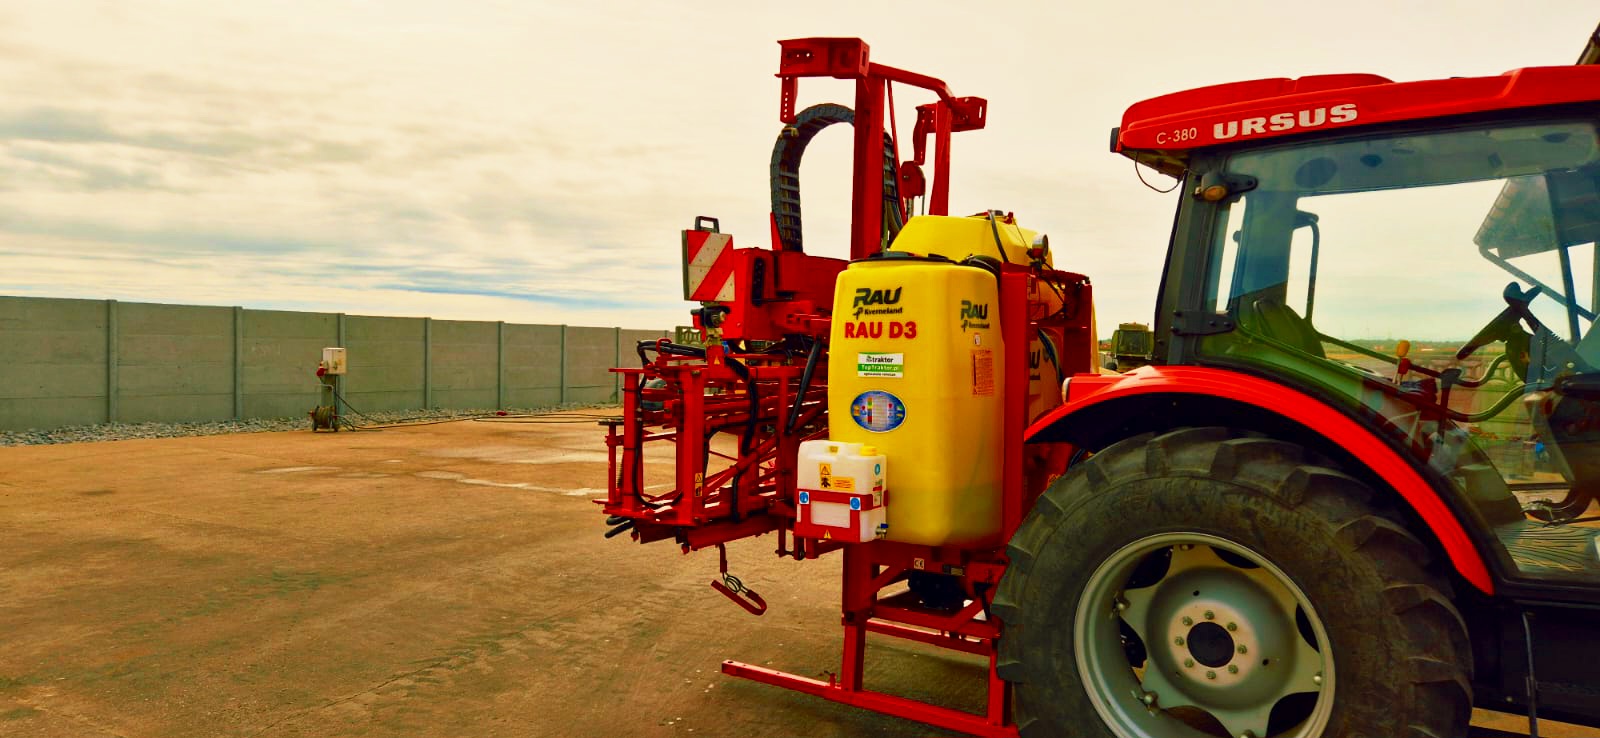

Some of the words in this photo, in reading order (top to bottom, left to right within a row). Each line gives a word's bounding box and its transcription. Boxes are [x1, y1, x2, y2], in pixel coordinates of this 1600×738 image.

[1213, 104, 1358, 139] URSUS
[1156, 127, 1197, 145] C-380
[853, 286, 902, 308] RAU
[864, 307, 903, 315] Kverneland
[960, 300, 988, 320] RAU
[845, 321, 883, 339] RAU
[889, 321, 917, 339] D3
